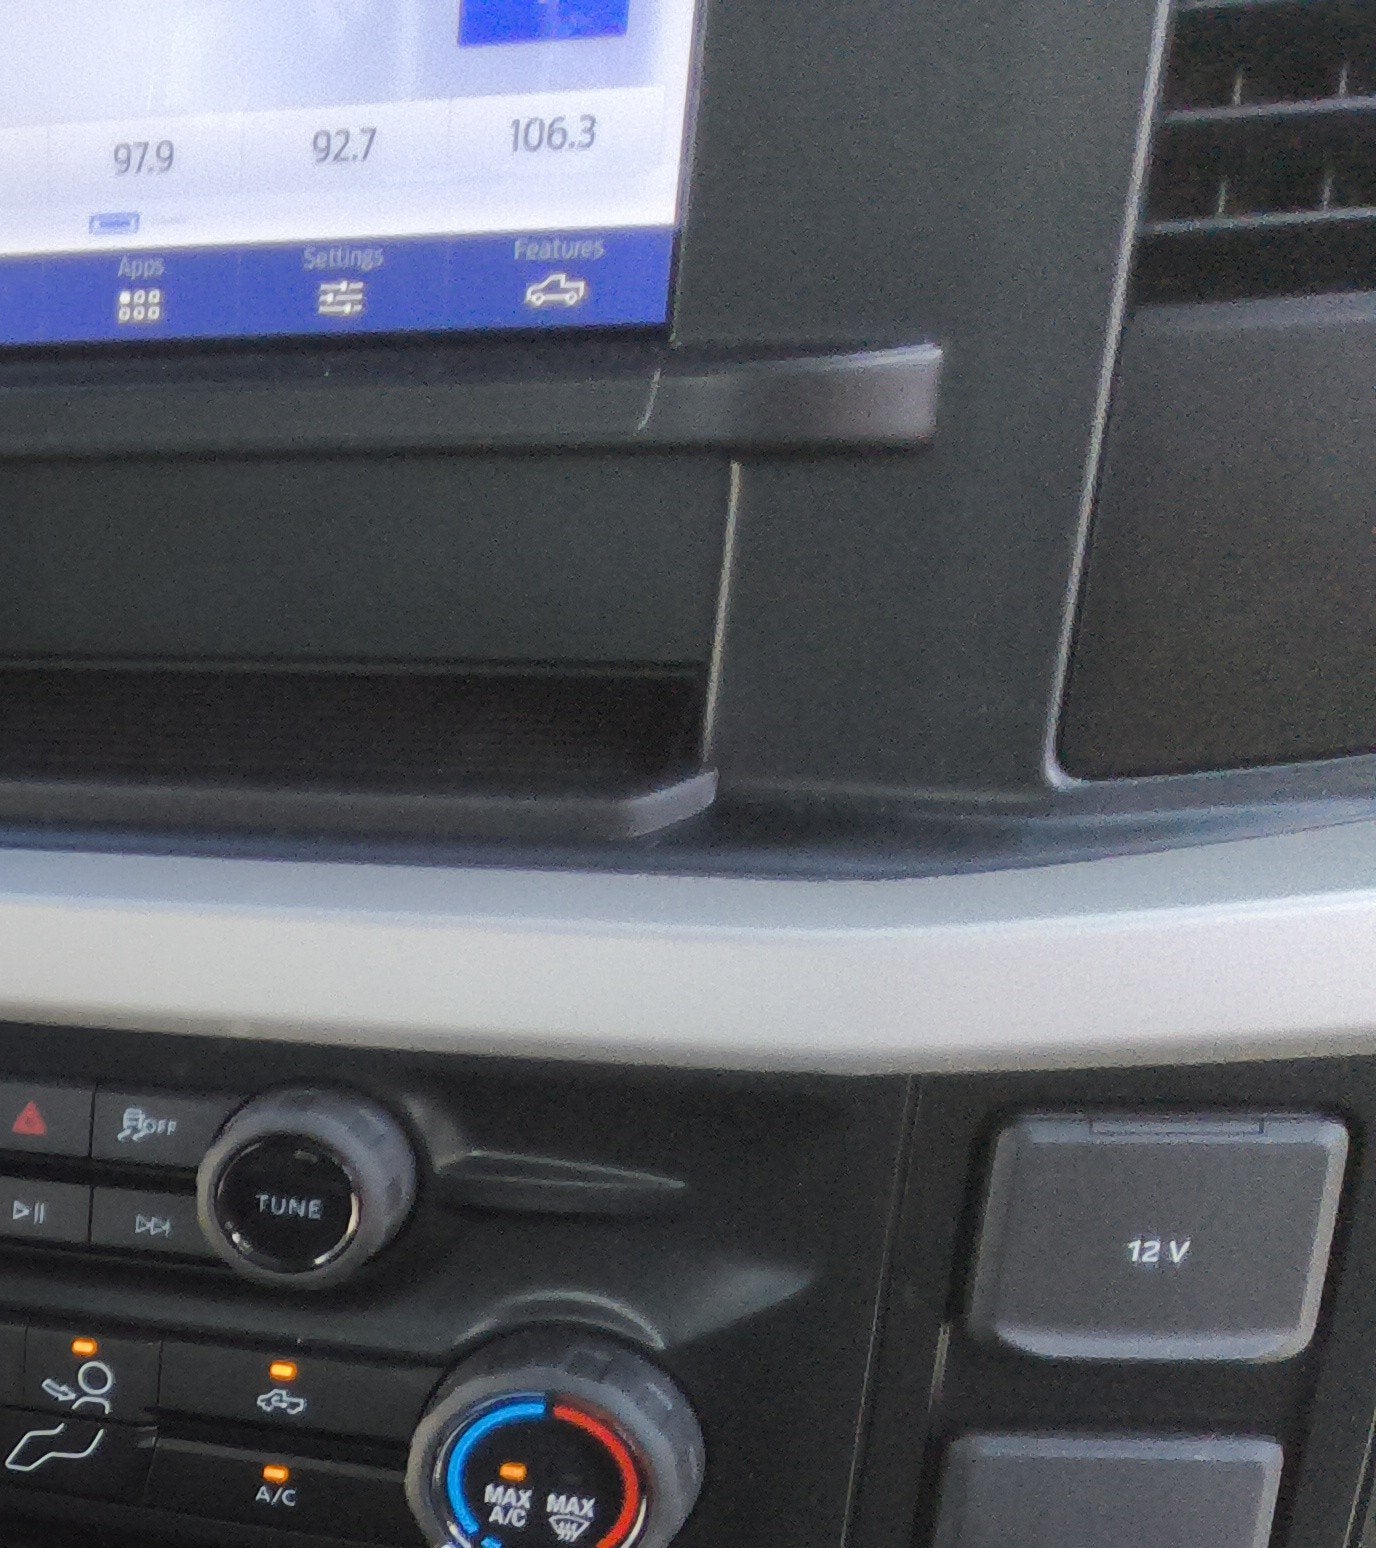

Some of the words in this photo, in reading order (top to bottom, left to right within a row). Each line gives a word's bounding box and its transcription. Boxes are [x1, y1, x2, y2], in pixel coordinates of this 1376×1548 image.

[312, 126, 377, 164] 92.7
[509, 113, 598, 153] 106.3
[113, 139, 175, 175] 97.9
[302, 243, 385, 271] Settings
[513, 235, 607, 261] Features
[117, 254, 165, 280] Apps
[142, 1118, 178, 1136] OFF
[255, 1194, 324, 1220] TUNE
[1127, 1239, 1161, 1263] 12
[1169, 1239, 1192, 1264] V
[254, 1486, 298, 1508] A/C
[483, 1483, 532, 1510] MAX
[545, 1492, 595, 1519] MAX
[488, 1504, 527, 1529] A/C
